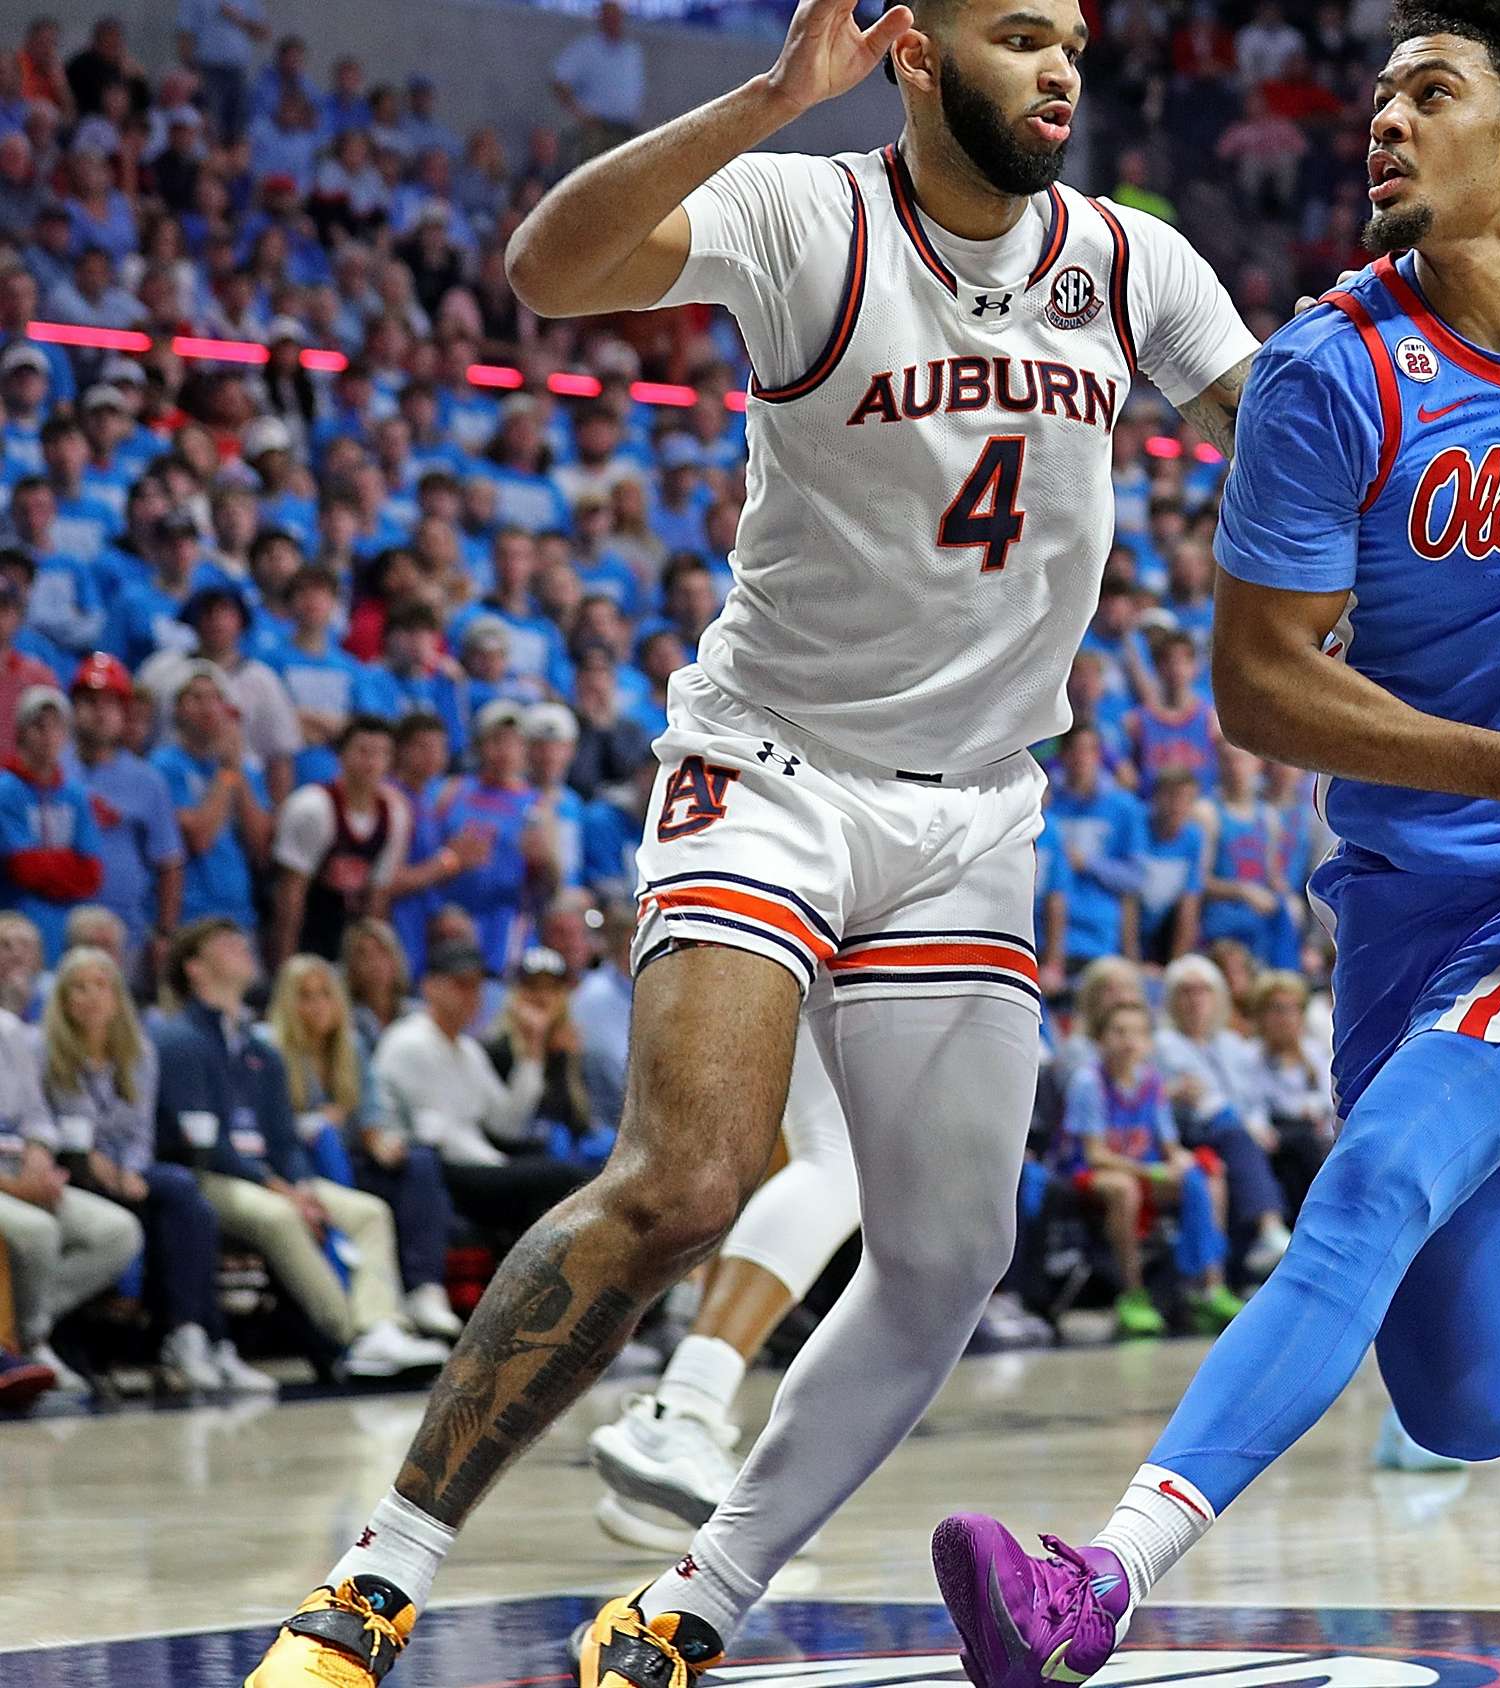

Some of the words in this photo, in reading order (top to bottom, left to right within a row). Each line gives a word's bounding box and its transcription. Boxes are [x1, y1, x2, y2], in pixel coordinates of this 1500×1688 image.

[1055, 270, 1091, 314] SEC
[1049, 309, 1095, 329] GRADUATE
[1405, 352, 1433, 374] 22
[846, 355, 1116, 433] AUBURN
[938, 435, 1026, 572] 4
